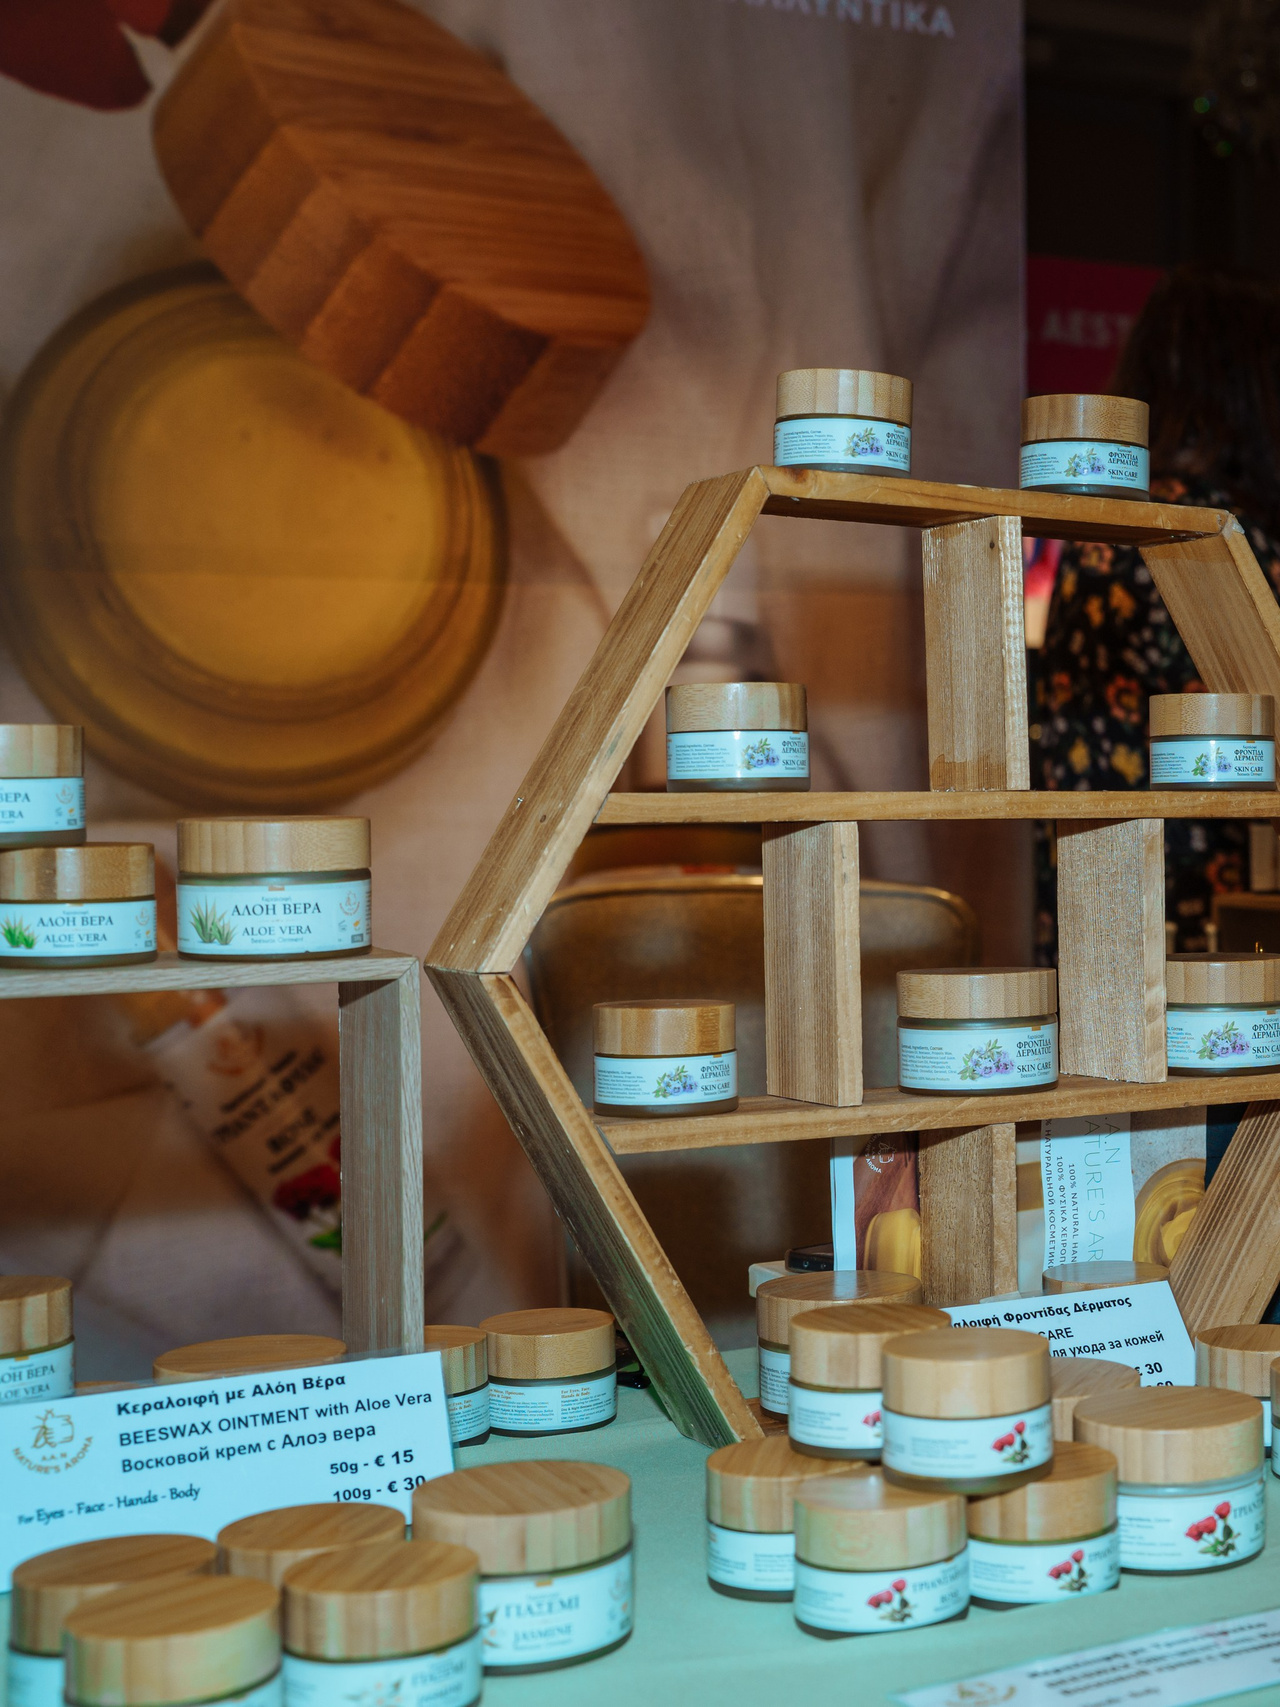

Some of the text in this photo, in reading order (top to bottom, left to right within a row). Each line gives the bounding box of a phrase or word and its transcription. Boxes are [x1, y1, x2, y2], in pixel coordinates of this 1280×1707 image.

[1108, 468, 1138, 478] SKIN CARE
[37, 915, 114, 927] ΑΛΟΗ ΒΕΡΑ
[231, 902, 321, 916] ΑΛΟΗ ΒΕΡΑ
[44, 933, 107, 943] ALOE VERA
[242, 925, 312, 937] ALOE VERA
[1252, 1046, 1270, 1054] SKIN
[1016, 1061, 1052, 1073] SKIN CARE
[701, 1084, 716, 1092] SKIN
[1105, 1117, 1121, 1164] .A.N
[866, 1158, 882, 1173] AROMA
[1044, 1129, 1056, 1205] НАТУРАЛЬНОЙ
[1084, 1120, 1106, 1261] ATURE'S AR
[1056, 1156, 1068, 1266] 100% ΦΥΣΙΚΑ ΧΕΙΡΟΠ
[1068, 1163, 1080, 1263] 100% NATURAL HAN
[952, 1296, 1132, 1329] αλοιφή Φροντίδας Δέρματος
[1051, 1330, 1164, 1358] ля ухода за кожей
[27, 1364, 55, 1380] ΒΕΡΑ
[1146, 1361, 1163, 1375] 30
[24, 1383, 50, 1395] VERA
[117, 1375, 346, 1415] Κεραλοιφή με Αλόη Βέρα
[119, 1392, 432, 1447] BEESWAX OINTMENT with Aloe Vera
[13, 1436, 93, 1475] NATURE'S AROMA
[122, 1424, 376, 1473] Восковой крем с Алоэ вера
[330, 1462, 359, 1475] 50g
[374, 1454, 385, 1467] €
[391, 1449, 414, 1464] 15
[333, 1487, 372, 1502] 100g
[387, 1481, 398, 1493] €
[403, 1474, 426, 1490] 30
[18, 1514, 34, 1525] For
[36, 1508, 65, 1525] Eyes
[76, 1502, 105, 1515] Face
[116, 1490, 158, 1508] Hands
[169, 1483, 201, 1501] Body
